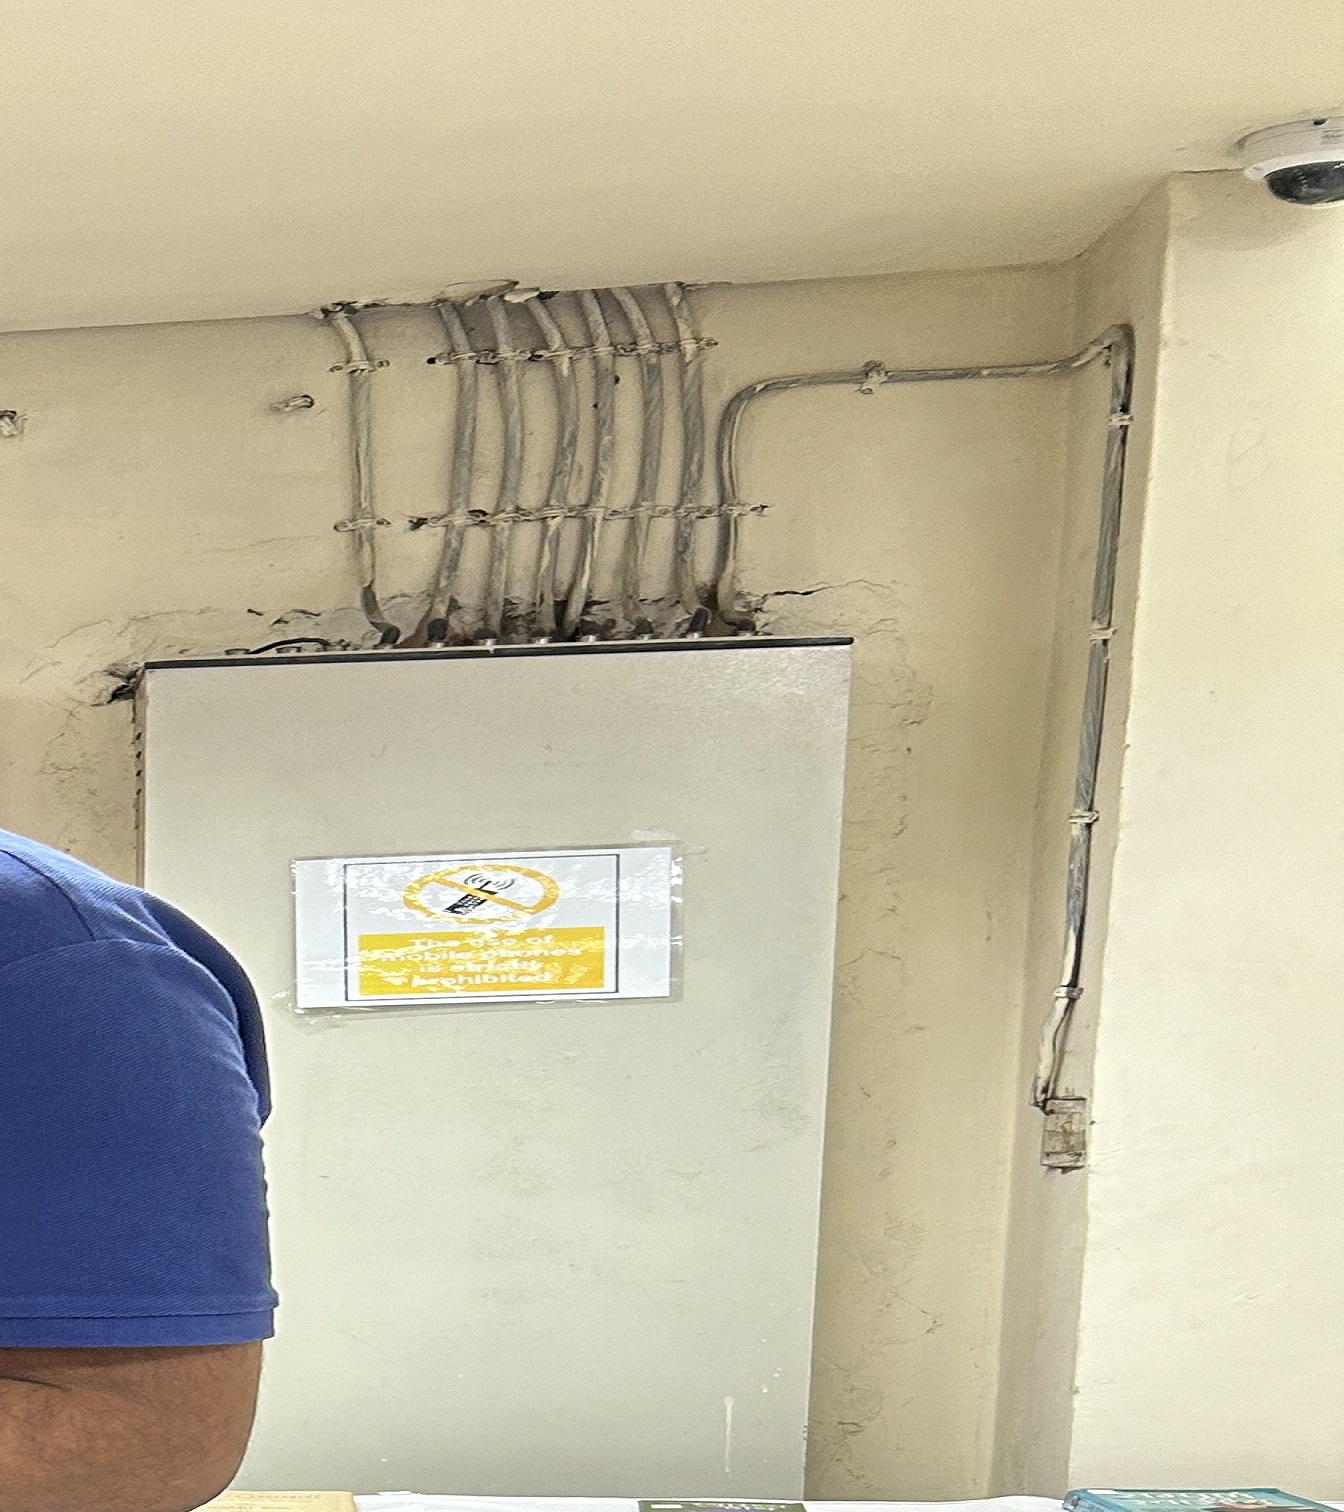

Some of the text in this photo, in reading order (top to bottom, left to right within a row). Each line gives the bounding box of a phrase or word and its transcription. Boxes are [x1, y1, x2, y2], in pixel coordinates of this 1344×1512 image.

[380, 946, 581, 962] mobile phones
[420, 959, 543, 974] is strictly
[411, 972, 551, 987] prohibited
